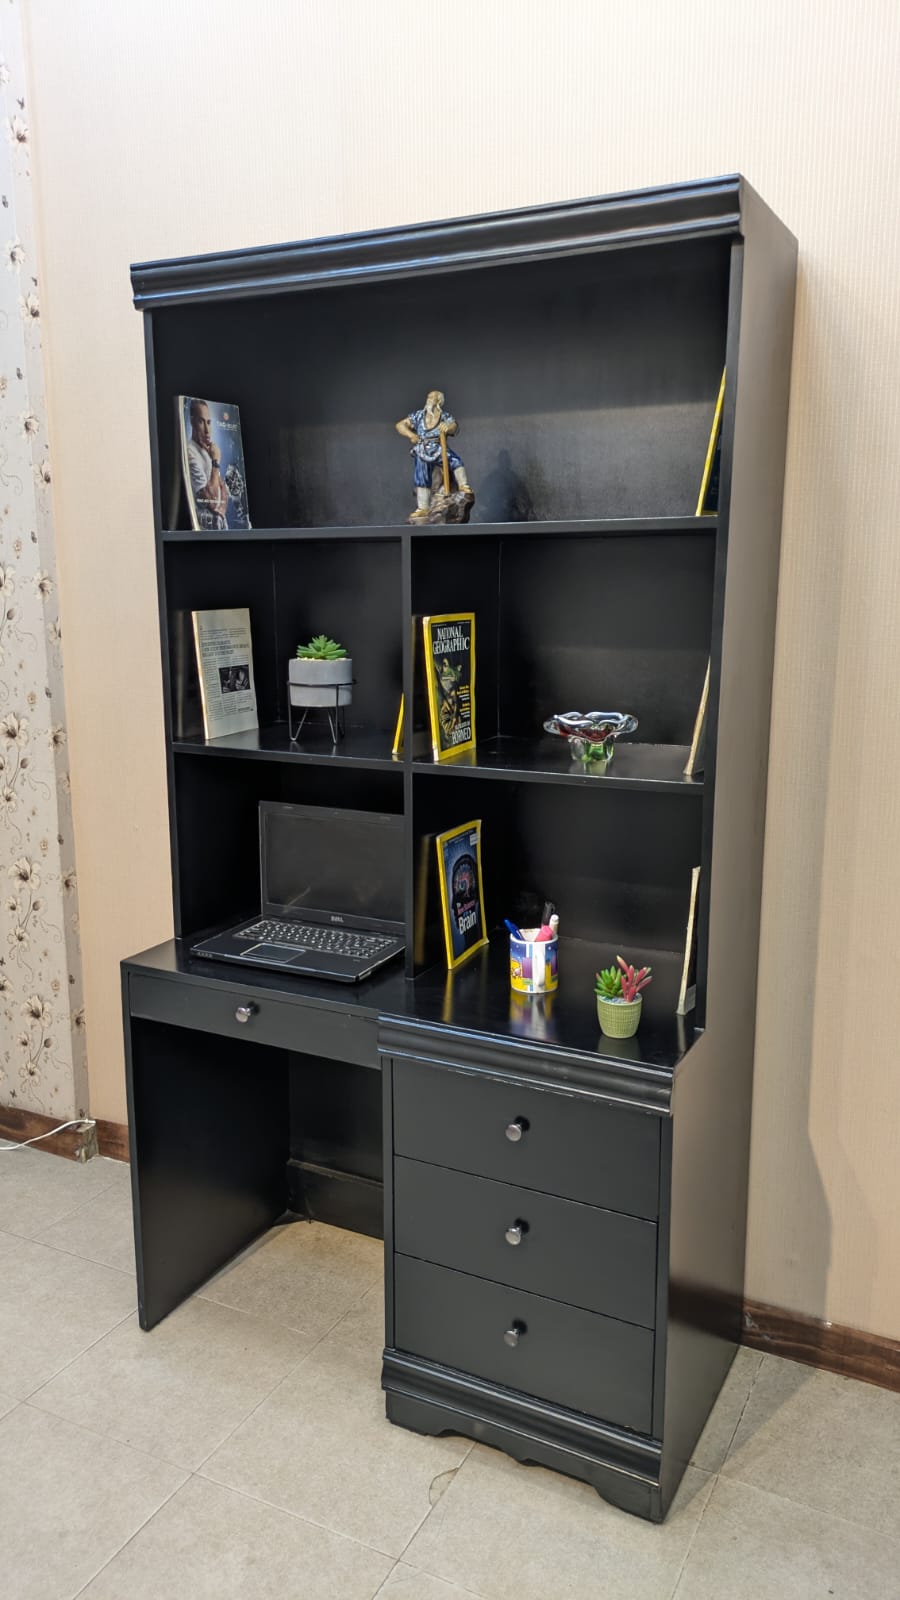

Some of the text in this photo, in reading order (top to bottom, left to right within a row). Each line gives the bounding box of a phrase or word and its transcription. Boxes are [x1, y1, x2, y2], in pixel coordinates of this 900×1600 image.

[437, 625, 463, 641] NATIONAL
[432, 637, 470, 655] GEOGRAPHIC
[457, 910, 477, 935] Brain
